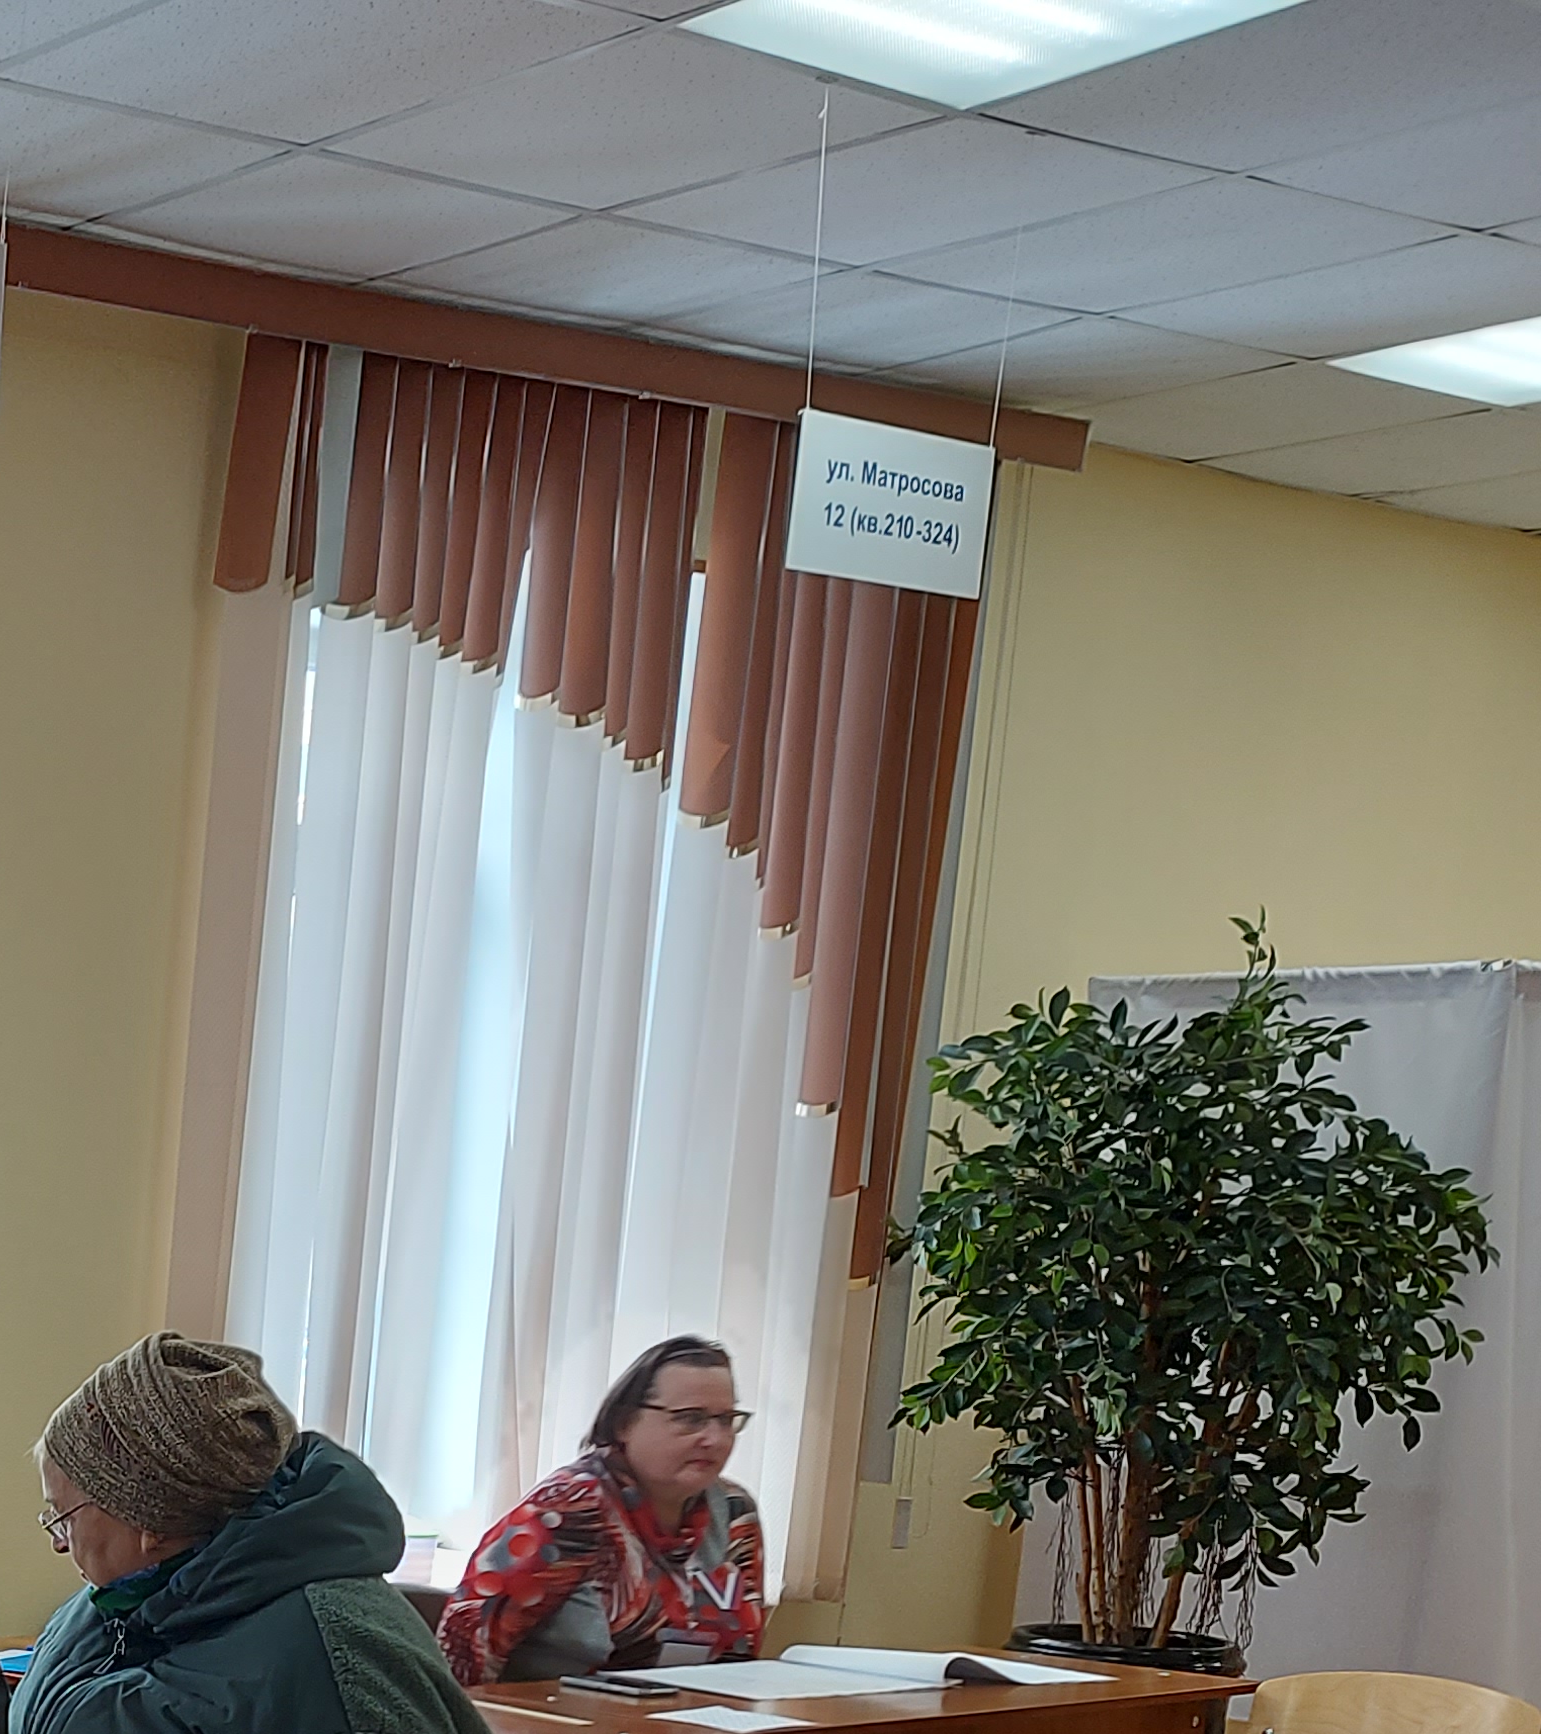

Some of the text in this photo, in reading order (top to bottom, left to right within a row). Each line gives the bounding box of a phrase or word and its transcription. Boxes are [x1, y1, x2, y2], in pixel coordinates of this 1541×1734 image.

[825, 458, 965, 503] ул. Матросова
[823, 501, 960, 555] 12 (кв.210-324)
